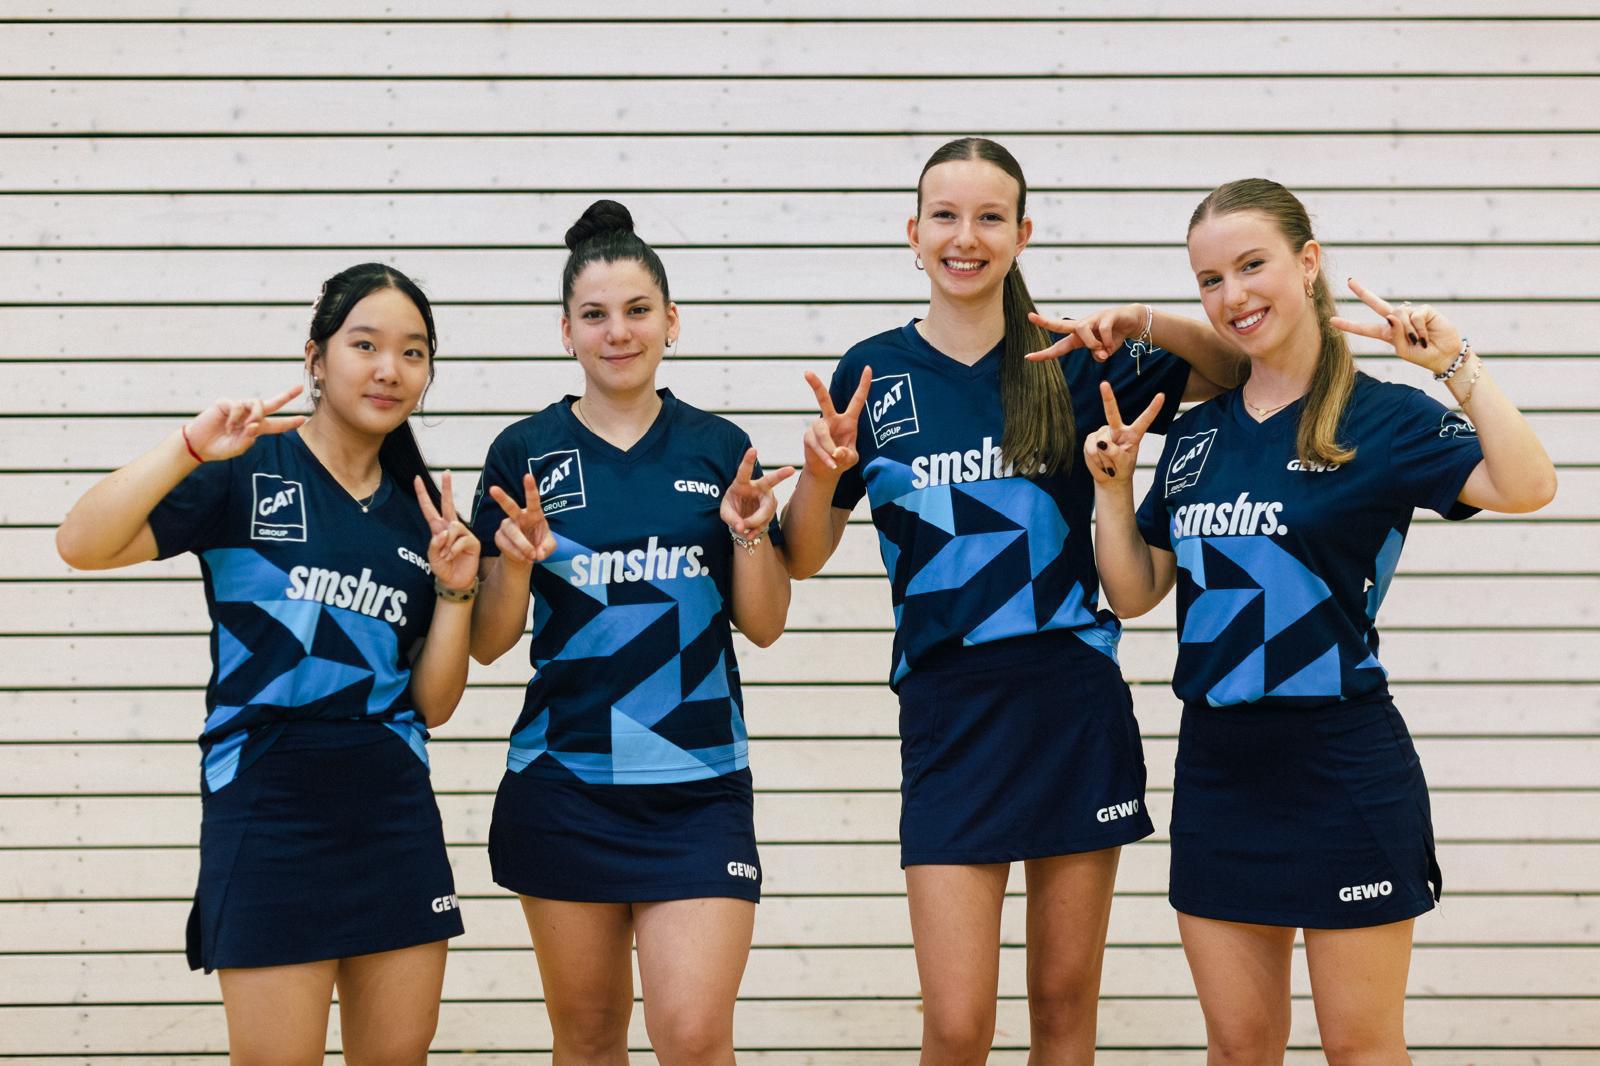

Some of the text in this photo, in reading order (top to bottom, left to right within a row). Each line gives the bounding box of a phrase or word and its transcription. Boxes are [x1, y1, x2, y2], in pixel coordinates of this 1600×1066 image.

[873, 382, 904, 423] CAT
[879, 426, 901, 441] GROUP
[1171, 437, 1210, 474] CAT
[539, 457, 573, 496] CAT
[674, 480, 719, 498] GEWO
[258, 488, 296, 517] CAT
[543, 499, 568, 512] GROUP
[1174, 492, 1288, 538] smshrs.
[258, 528, 289, 537] GROUP
[397, 546, 431, 575] GEWO
[570, 536, 709, 587] smshrs.
[285, 565, 408, 627] smshrs.
[1096, 799, 1139, 823] GEWO
[727, 861, 757, 880] GEWO
[1338, 880, 1393, 902] GEWO
